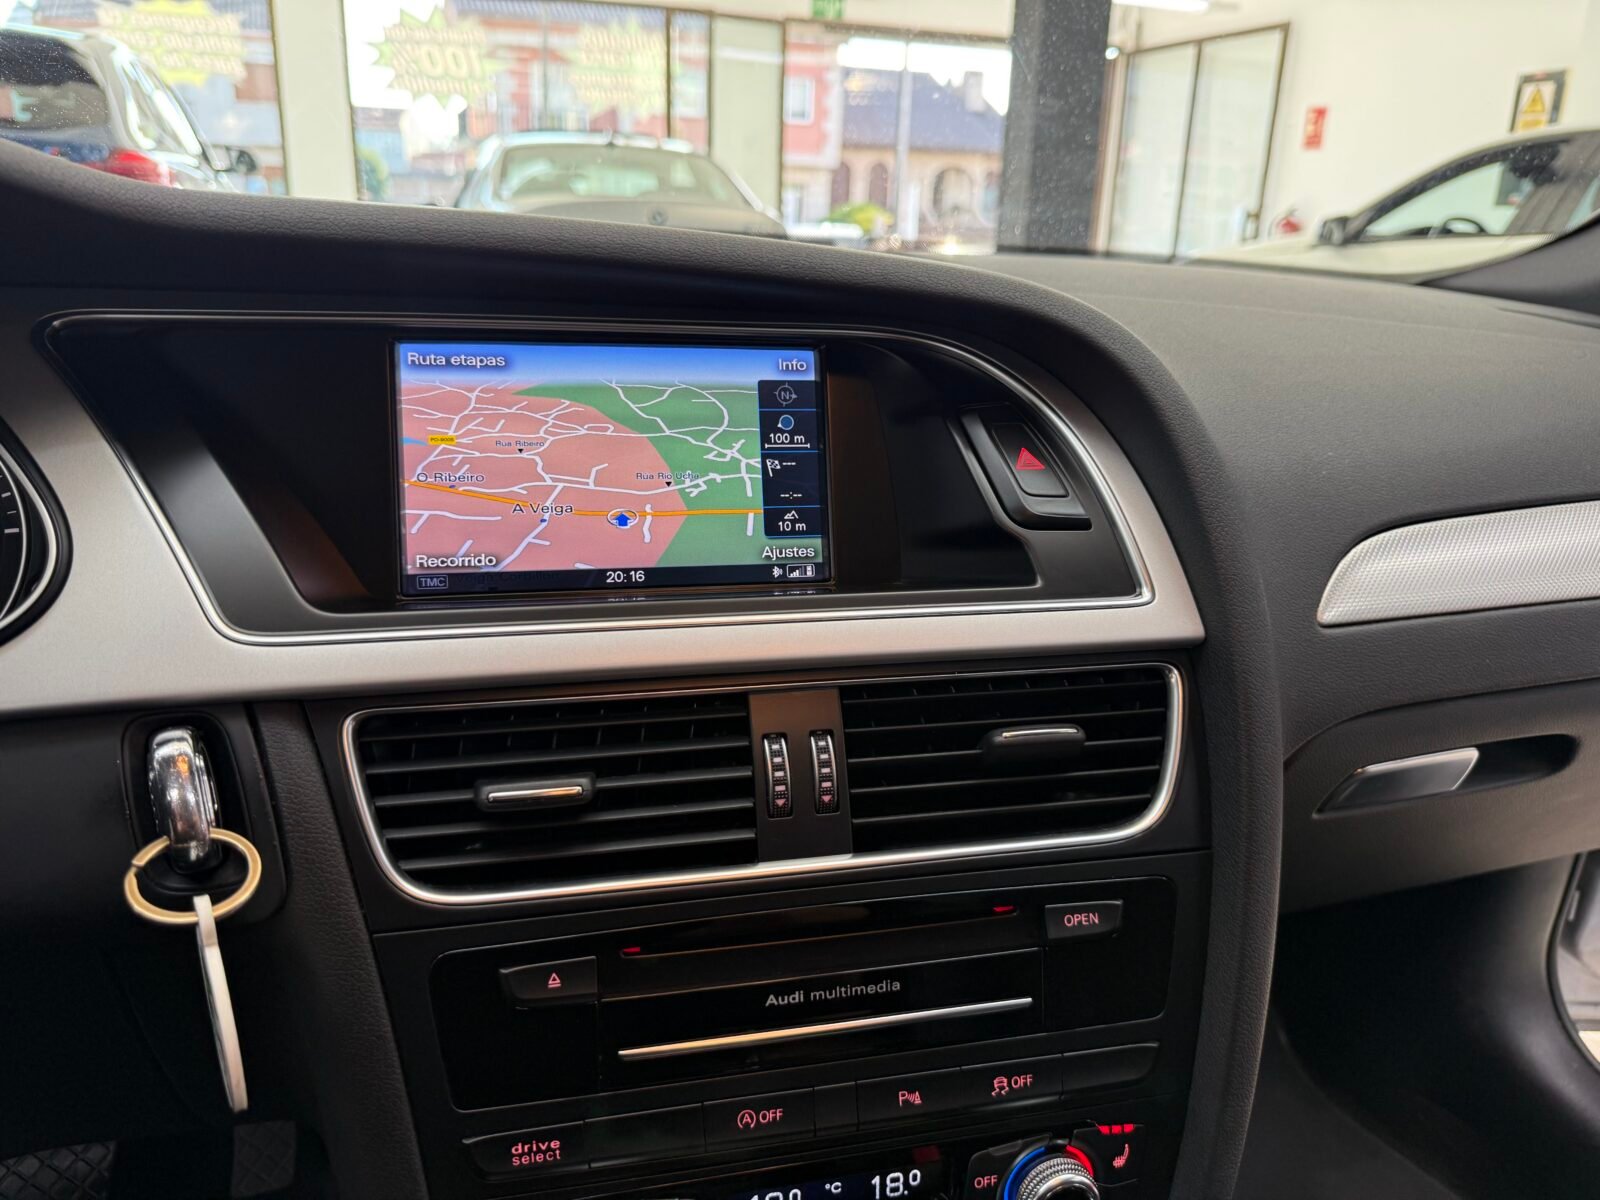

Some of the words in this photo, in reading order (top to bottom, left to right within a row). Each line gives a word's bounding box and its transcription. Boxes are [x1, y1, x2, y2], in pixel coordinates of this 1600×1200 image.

[408, 352, 446, 365] Ruta
[450, 354, 505, 369] etapas
[778, 358, 807, 371] Info
[769, 433, 790, 443] 100
[794, 435, 805, 443] m
[416, 473, 428, 482] O
[434, 472, 485, 482] Ribeiro
[675, 472, 699, 480] Ucha
[512, 504, 525, 514] A
[530, 503, 573, 515] Veiga
[778, 521, 792, 531] 10
[795, 523, 807, 531] m
[762, 546, 815, 560] Ajustes
[415, 554, 497, 568] Recorrido
[419, 577, 446, 588] TMC
[606, 570, 645, 583] 20:16
[1064, 912, 1099, 927] OPEN
[765, 991, 804, 1007] Audi
[810, 979, 901, 1001] multimedia
[1011, 1074, 1033, 1088] OFF
[759, 1108, 783, 1123] OFF
[511, 1140, 560, 1154] drive
[512, 1149, 561, 1166] select
[974, 1175, 998, 1189] OFF
